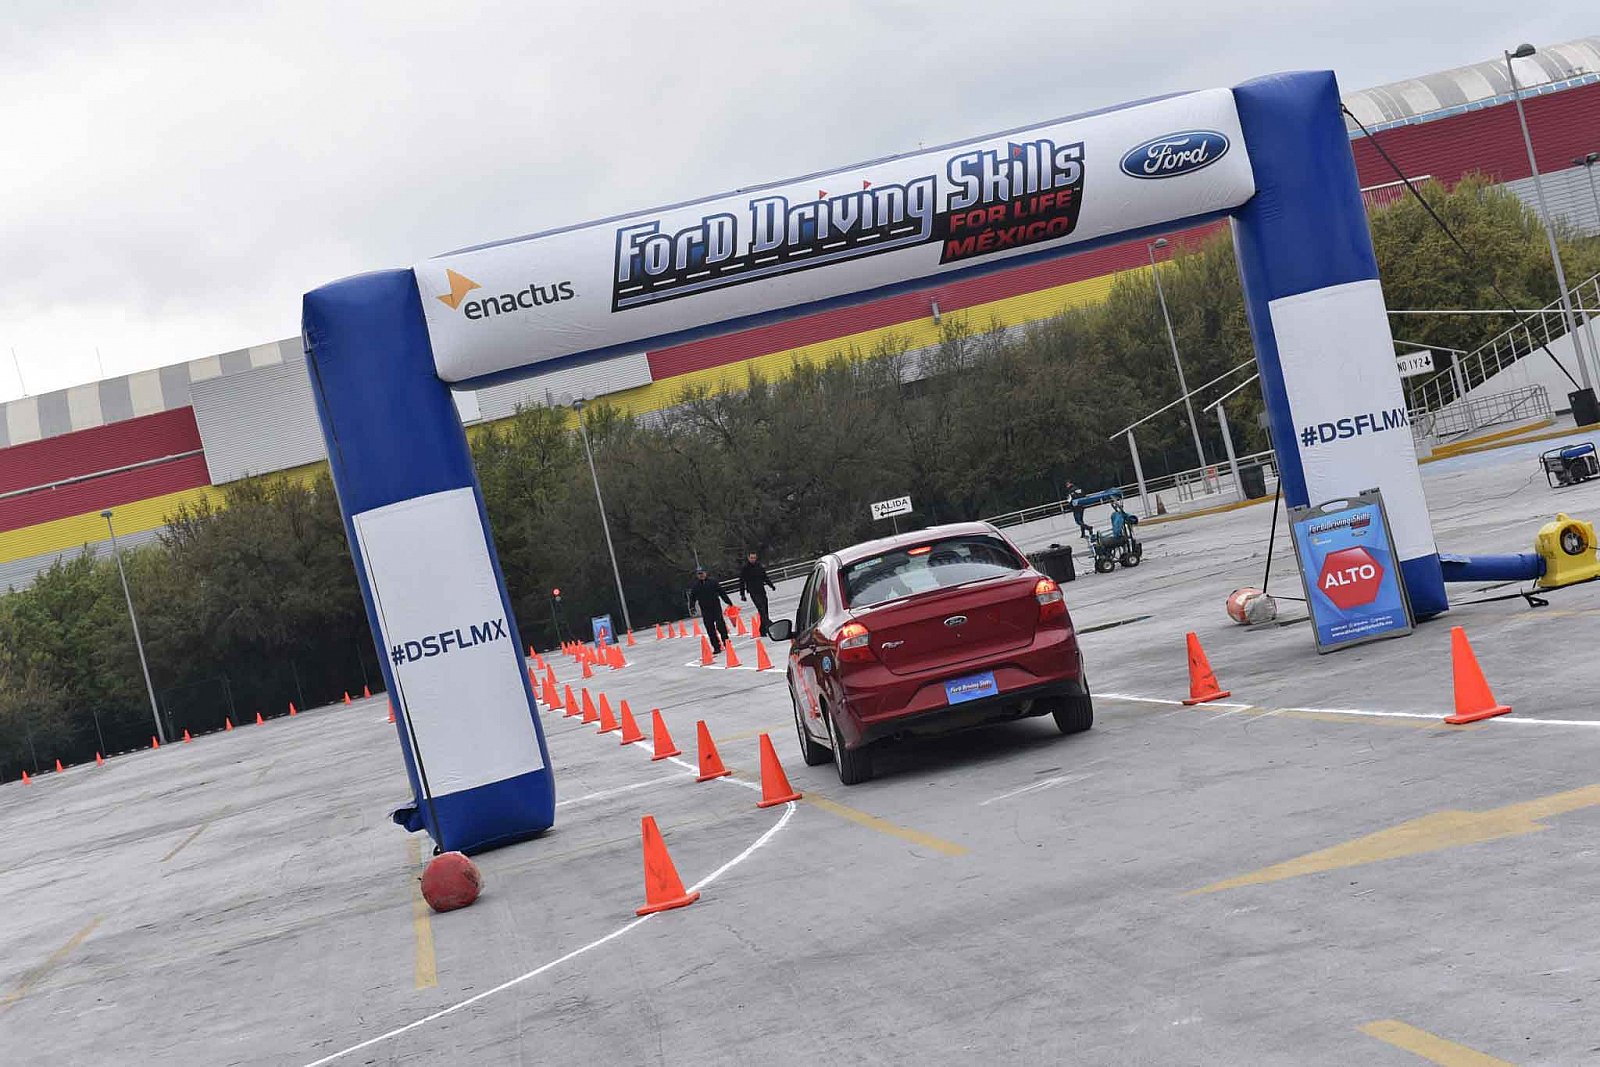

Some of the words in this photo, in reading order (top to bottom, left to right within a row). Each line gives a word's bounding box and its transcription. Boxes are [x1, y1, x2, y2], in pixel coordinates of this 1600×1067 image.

[1143, 138, 1208, 173] Ford
[749, 174, 937, 253] Driving
[946, 139, 1085, 208] Skills
[949, 205, 1007, 234] FOR
[1014, 189, 1073, 220] LIFE
[944, 216, 1070, 258] MÉXICO
[464, 280, 575, 320] enactus
[1300, 407, 1408, 447] #DSFLMX
[874, 499, 908, 512] SALIDA
[1324, 564, 1376, 589] ALTO
[391, 618, 508, 666] #DSFLMX
